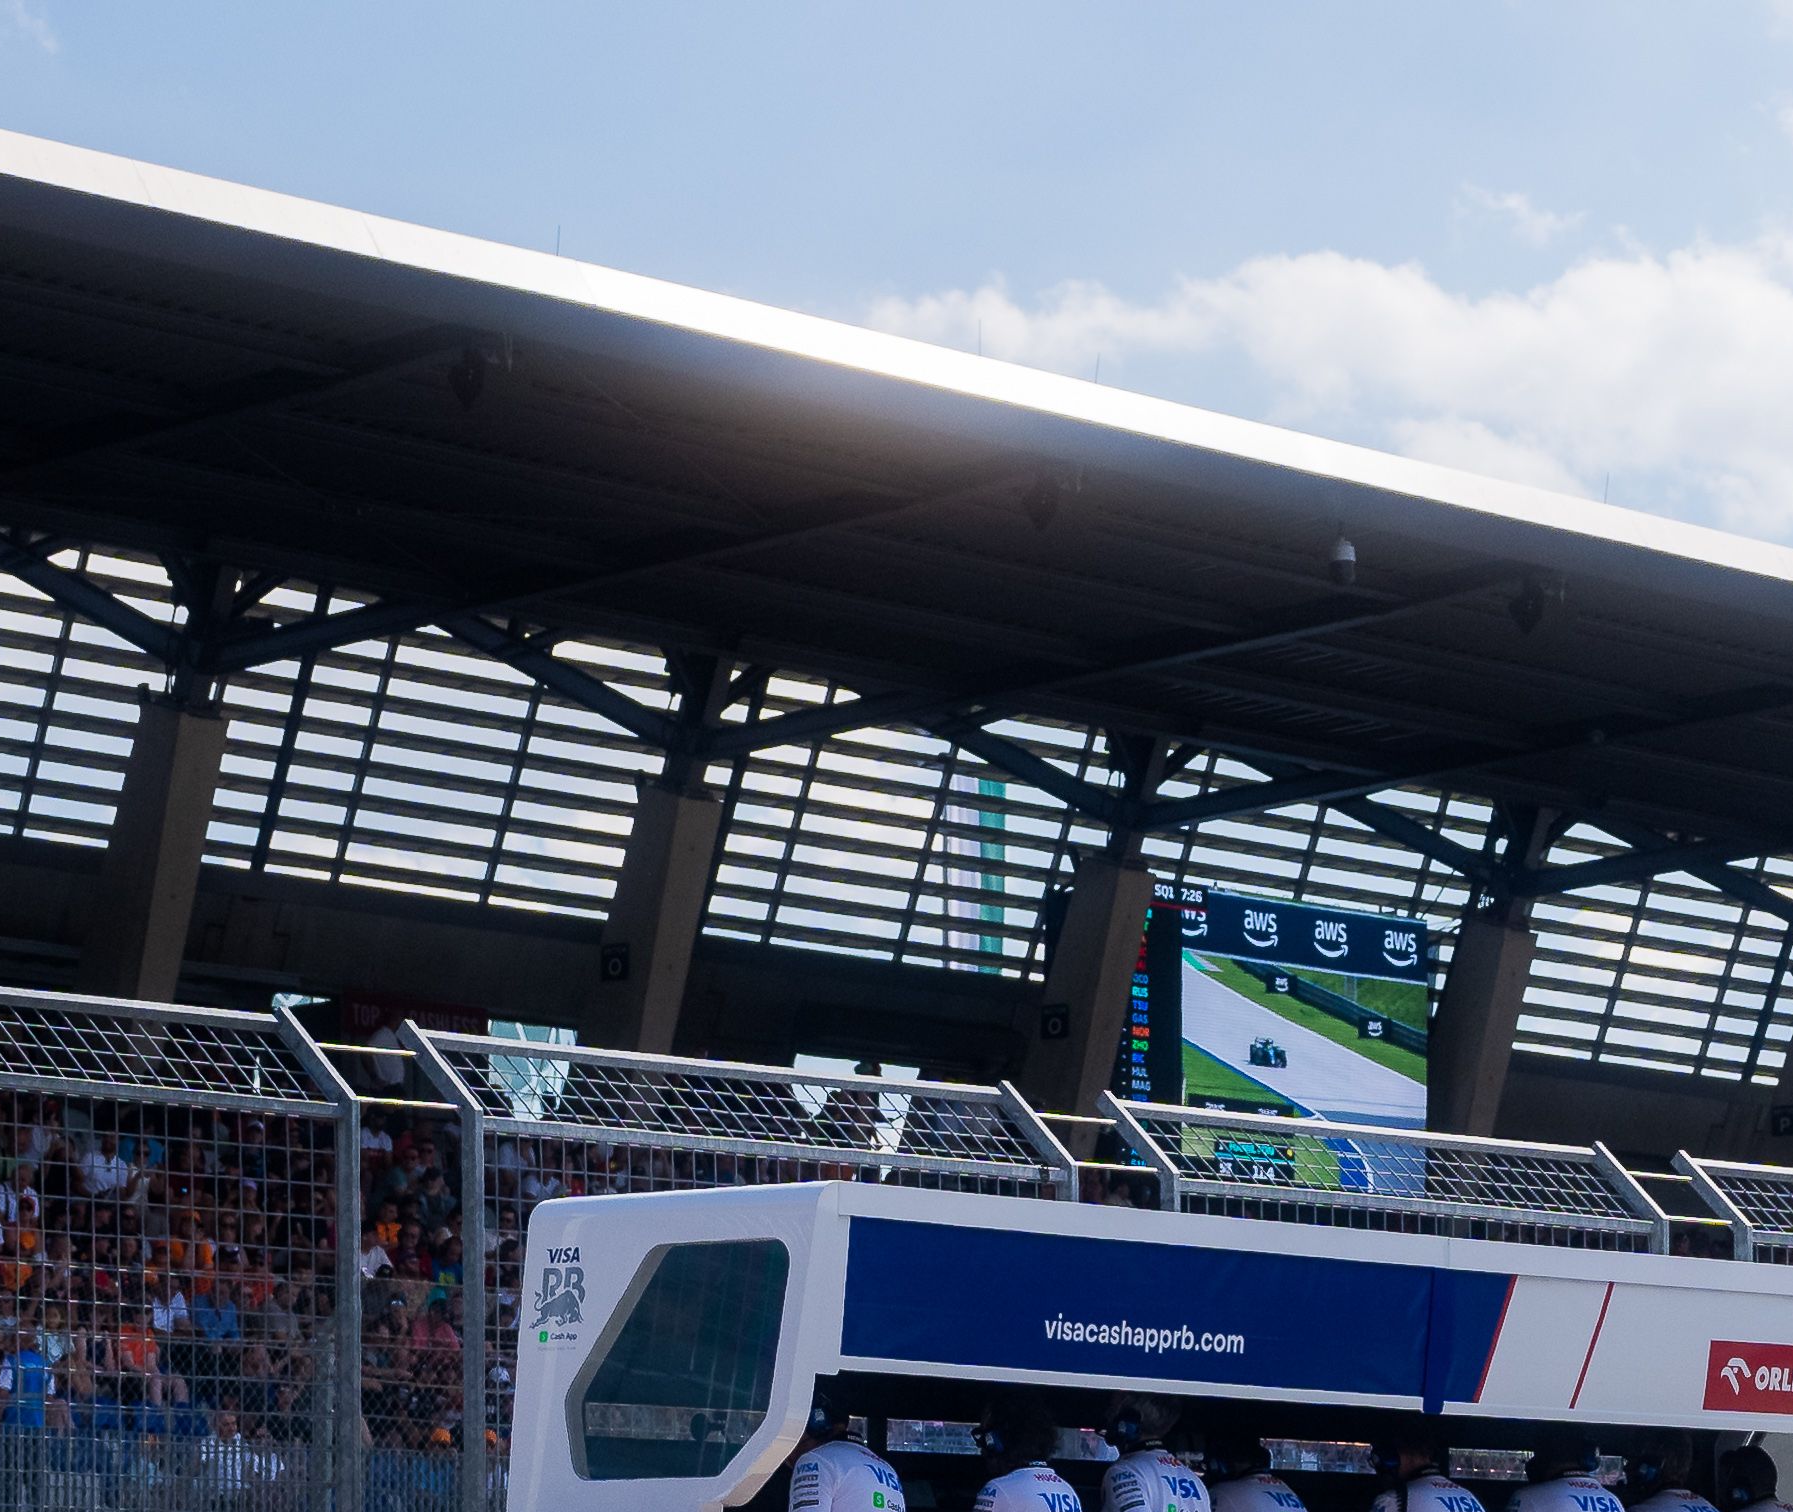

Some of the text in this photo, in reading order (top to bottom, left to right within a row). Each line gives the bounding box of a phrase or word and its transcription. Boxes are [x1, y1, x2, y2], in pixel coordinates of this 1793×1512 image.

[1154, 884, 1203, 903] SQ1 7:26
[1244, 910, 1277, 932] aws
[1315, 920, 1347, 942] aws
[1384, 930, 1416, 952] aws
[1132, 1080, 1151, 1092] MAG
[547, 1247, 581, 1264] VISA
[550, 1332, 578, 1343] Cash App
[1044, 1313, 1245, 1354] visacashapprb.com
